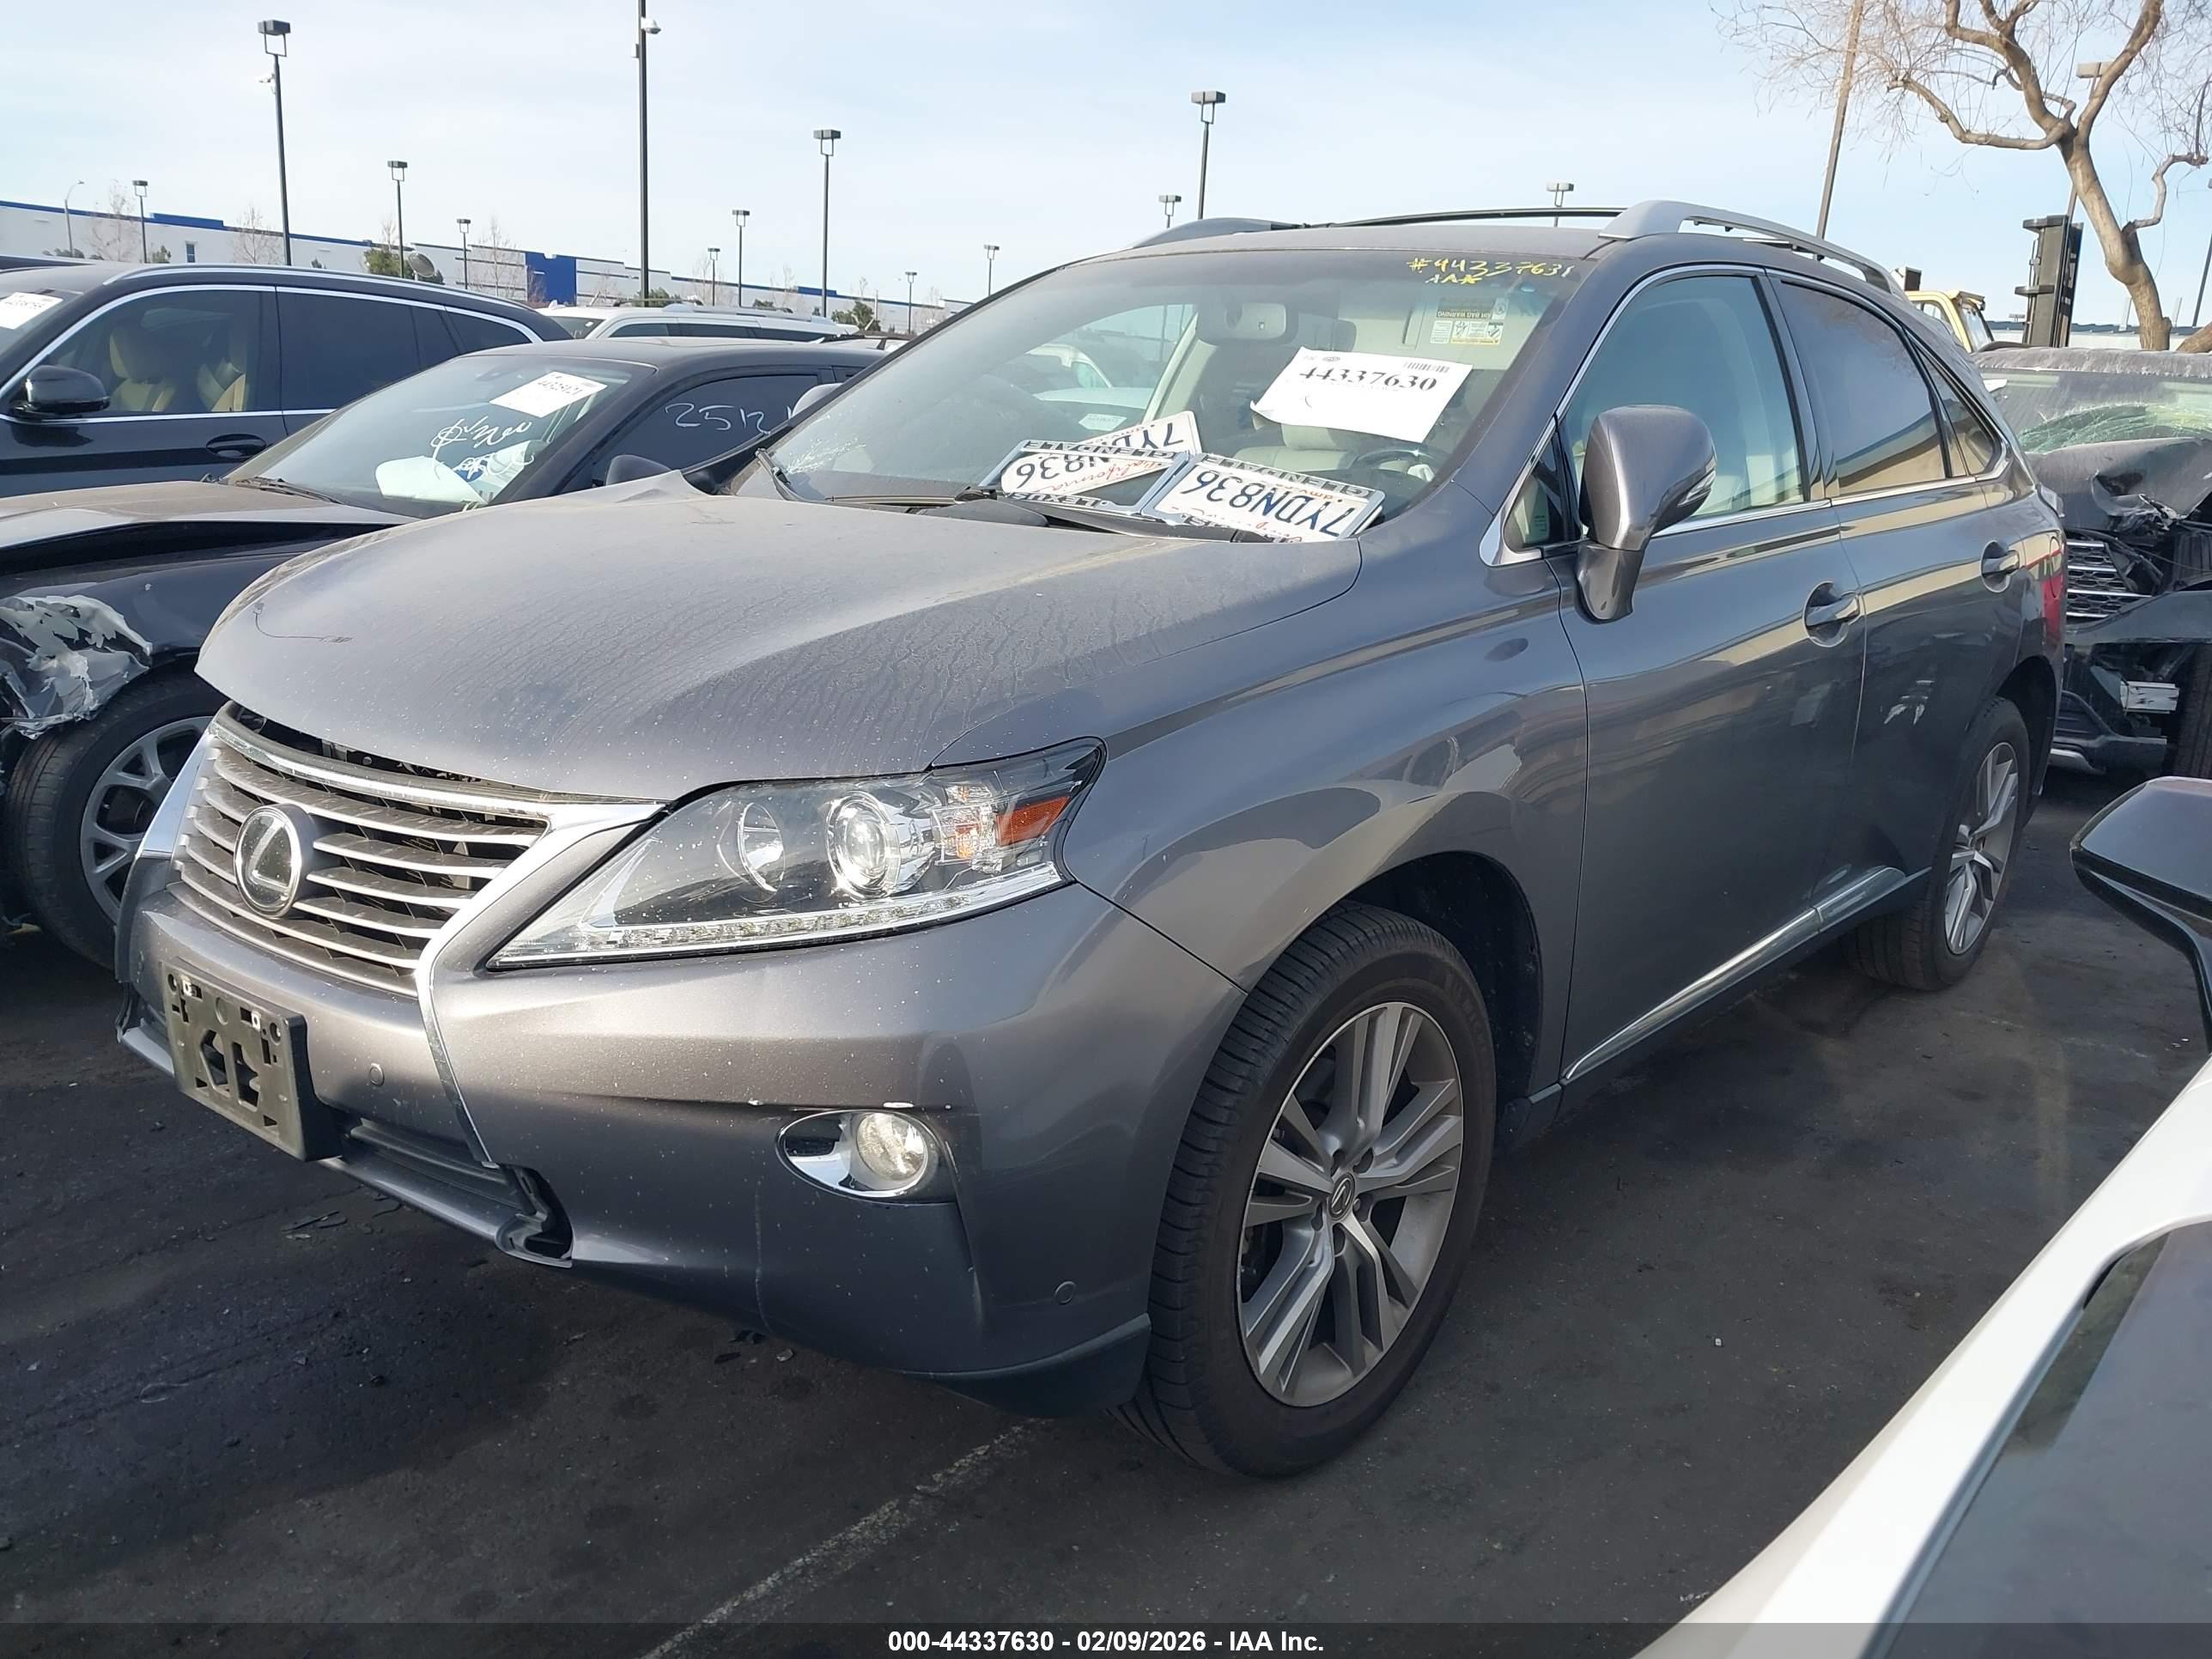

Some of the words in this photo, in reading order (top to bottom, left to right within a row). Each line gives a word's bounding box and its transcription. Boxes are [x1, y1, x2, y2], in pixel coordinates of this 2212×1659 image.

[1299, 366, 1437, 392] 44337630
[1027, 440, 1175, 459] GLENDALE
[1203, 454, 1372, 497] GLENDALE
[1010, 492, 1099, 508] LEXUS
[1180, 468, 1356, 538] 7YDN836
